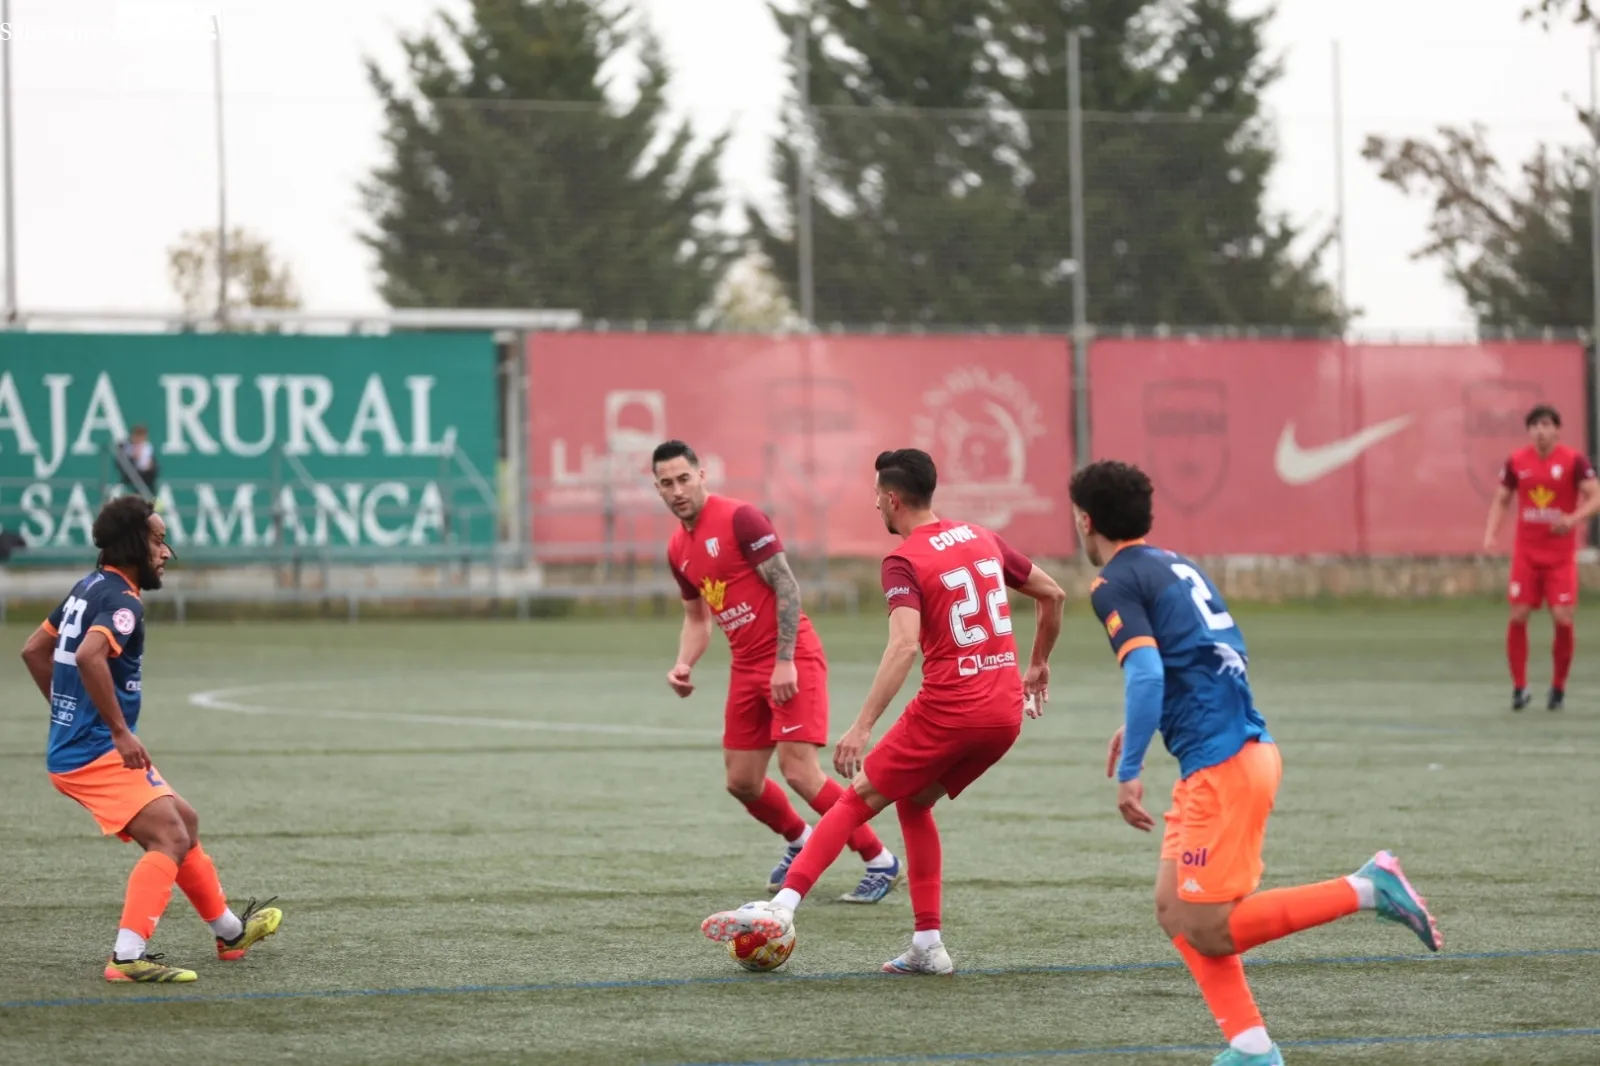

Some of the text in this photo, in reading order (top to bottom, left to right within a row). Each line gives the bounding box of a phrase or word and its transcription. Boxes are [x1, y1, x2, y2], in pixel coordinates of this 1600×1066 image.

[158, 372, 456, 457] RURAL
[19, 481, 446, 548] SAAMANCA
[928, 524, 978, 551] COQUE
[940, 557, 1013, 648] 22
[1171, 563, 1234, 630] 2
[1182, 847, 1207, 868] oil
